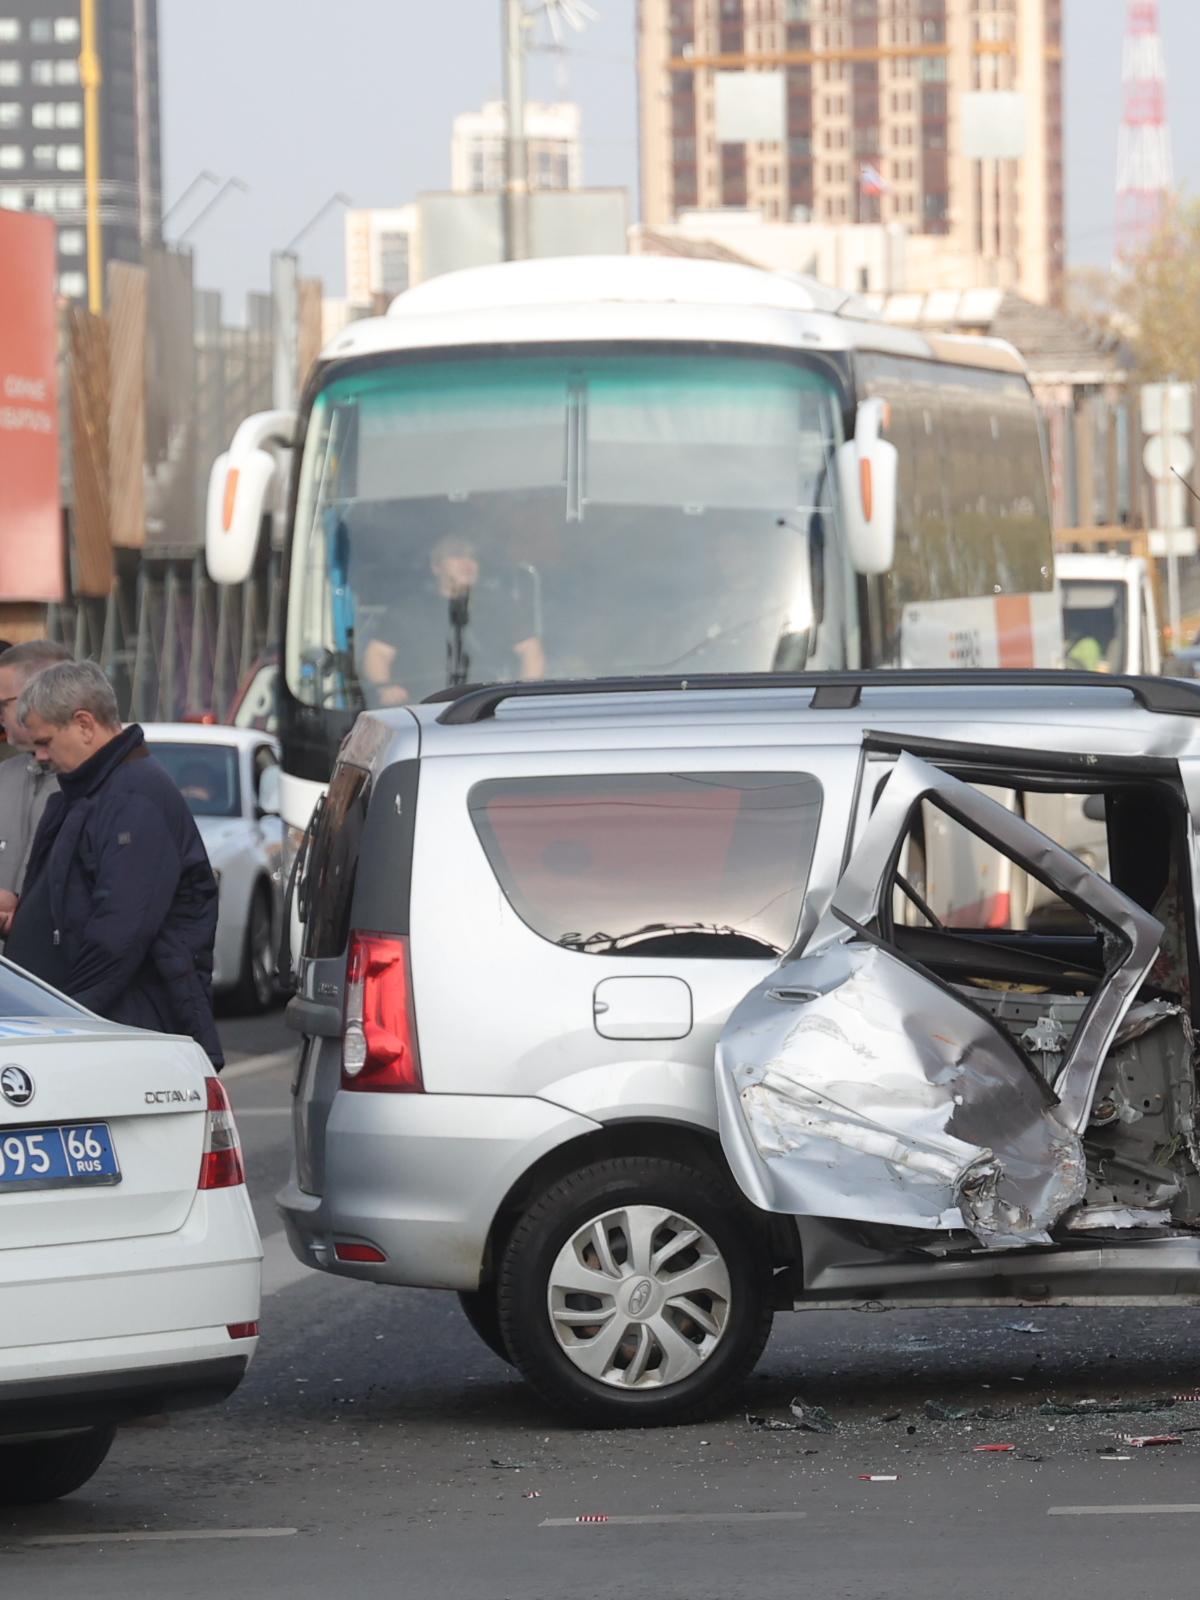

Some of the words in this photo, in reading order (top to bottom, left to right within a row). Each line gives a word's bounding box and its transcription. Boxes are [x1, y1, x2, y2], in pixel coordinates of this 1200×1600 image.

[144, 1089, 201, 1105] OCTAVIA
[67, 1128, 102, 1160] 66
[76, 1159, 102, 1173] RUS
